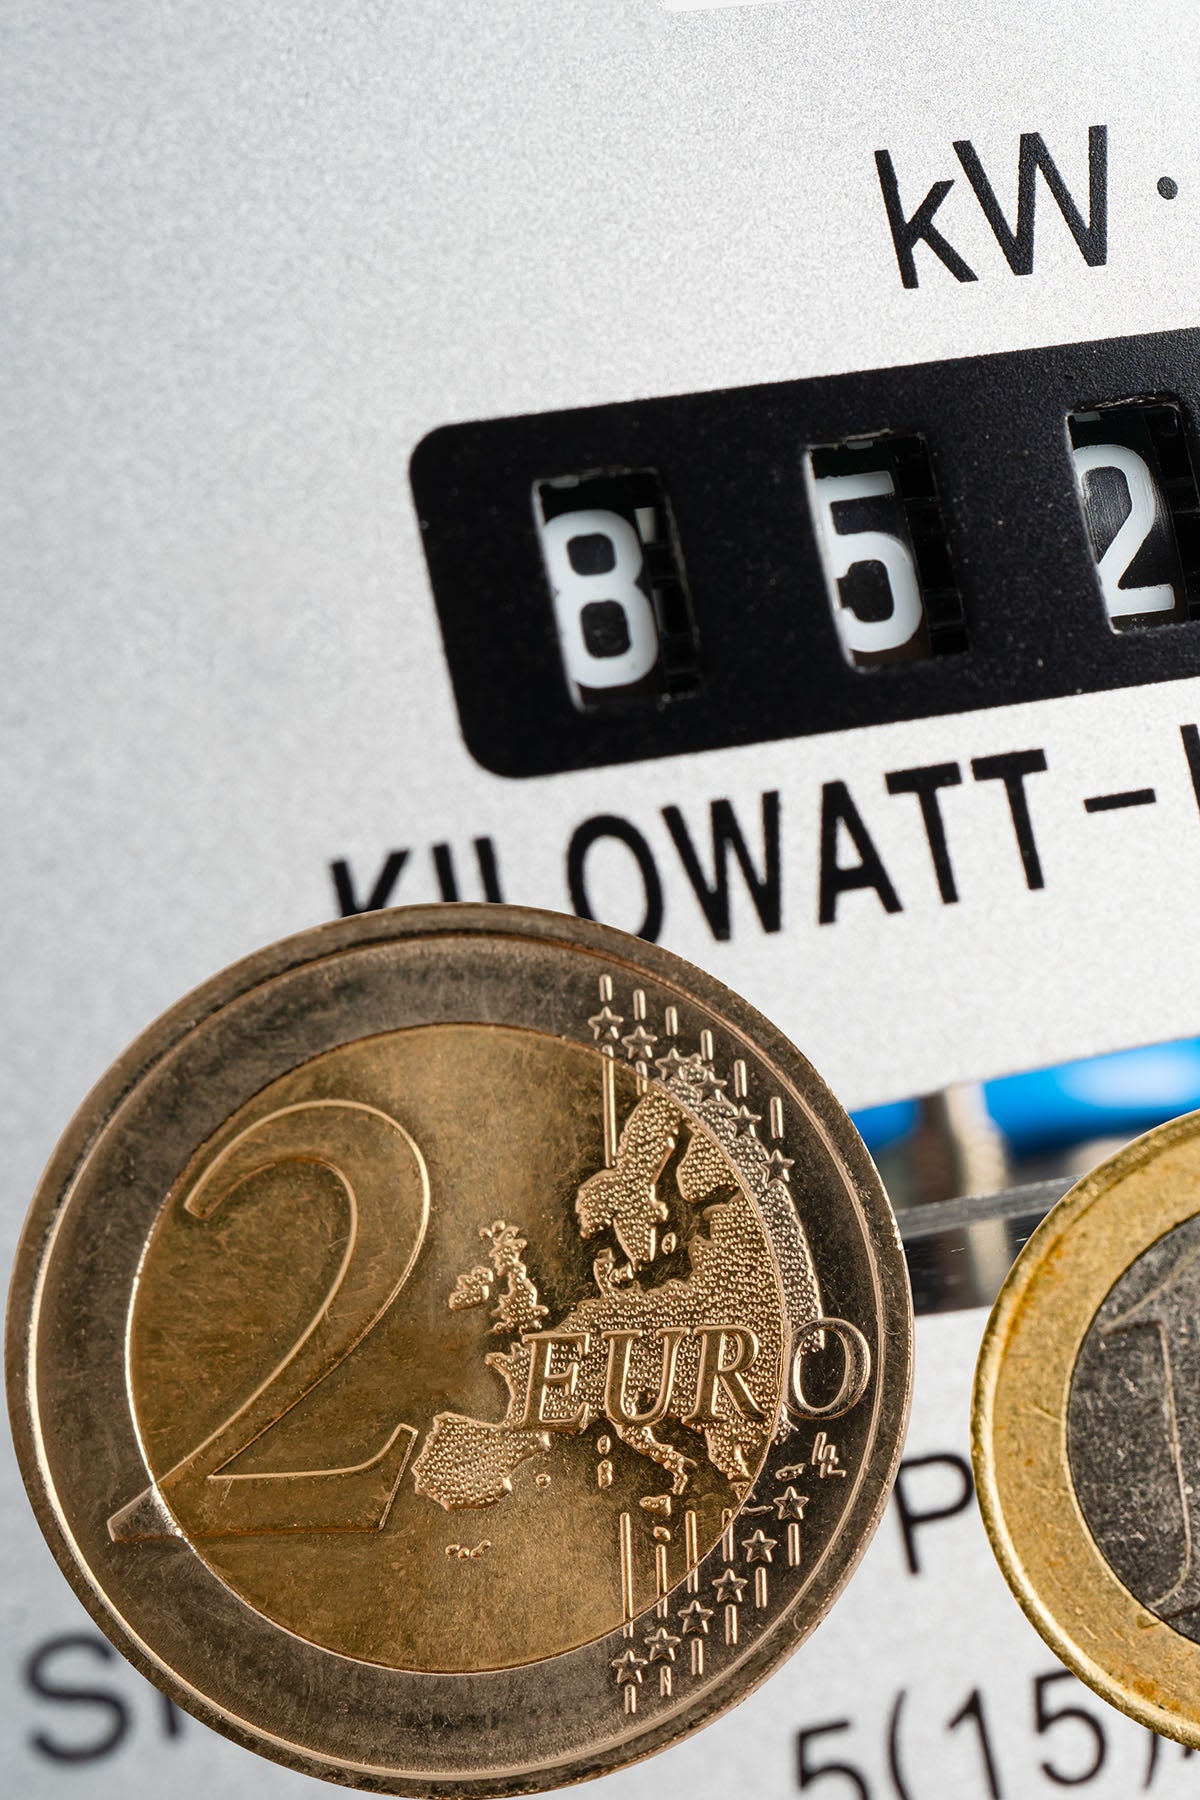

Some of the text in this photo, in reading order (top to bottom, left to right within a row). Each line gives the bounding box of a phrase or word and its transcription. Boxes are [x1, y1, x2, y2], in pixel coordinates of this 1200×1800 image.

[108, 1099, 873, 1543] 2 EURO
[894, 1453, 975, 1575] P
